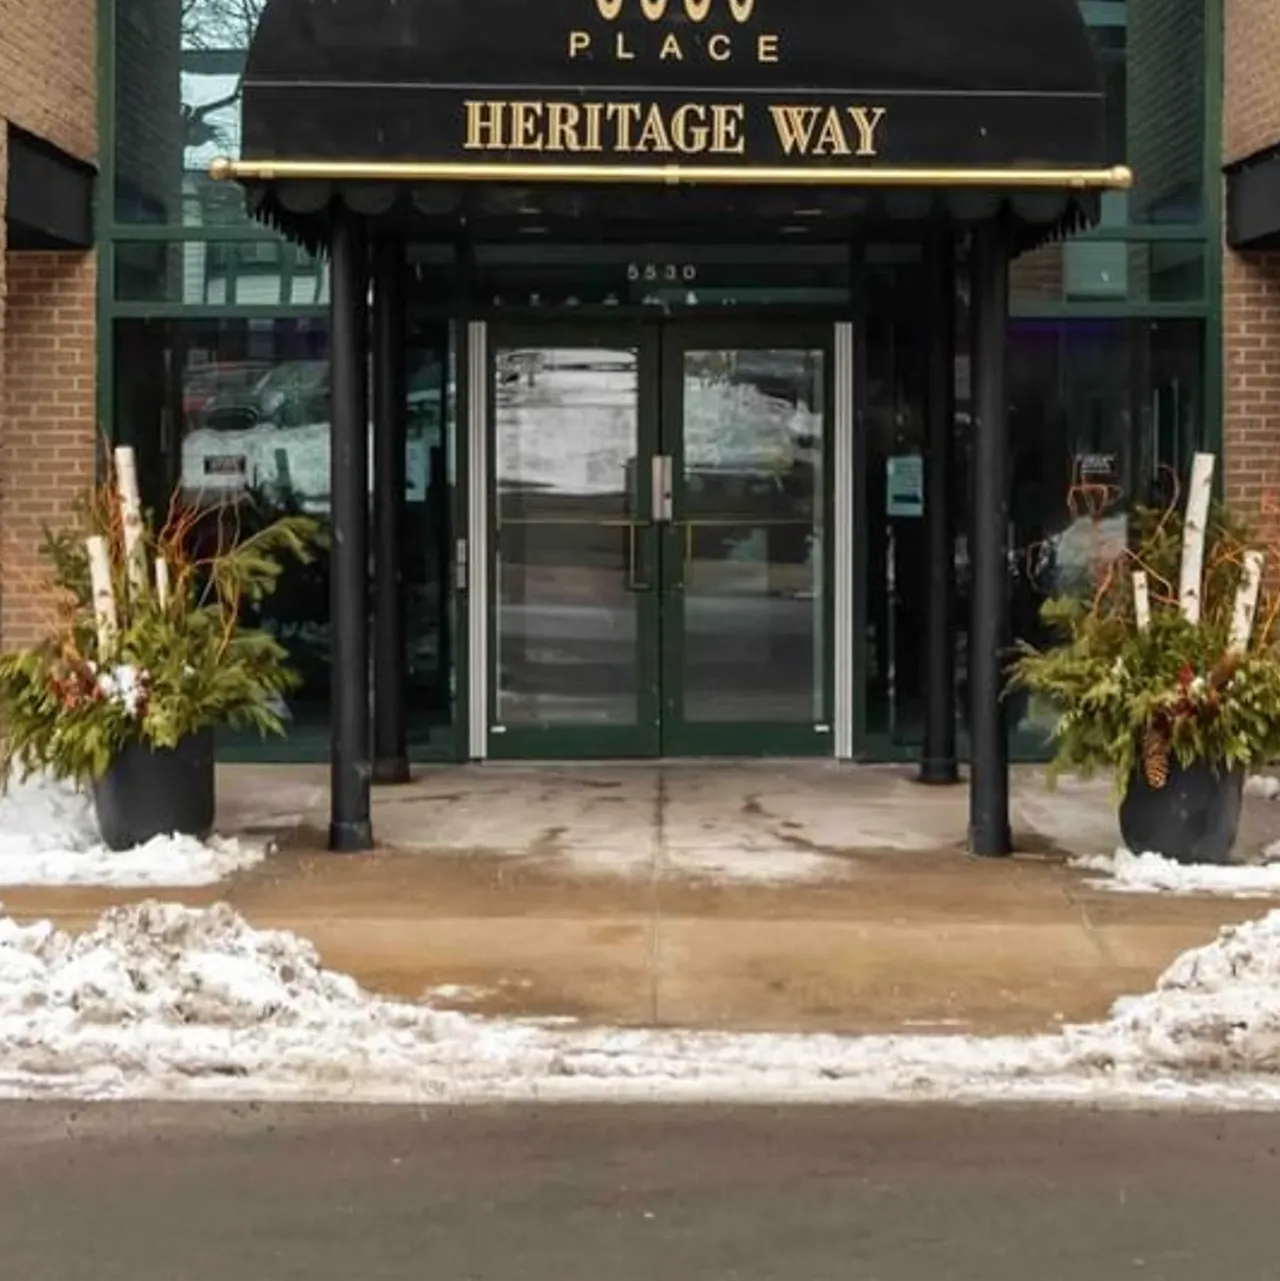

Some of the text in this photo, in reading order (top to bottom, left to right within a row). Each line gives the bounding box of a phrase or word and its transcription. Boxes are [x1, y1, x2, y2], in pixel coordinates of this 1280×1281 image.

[569, 31, 779, 62] PLACE
[463, 100, 886, 156] HERITAGE WAY
